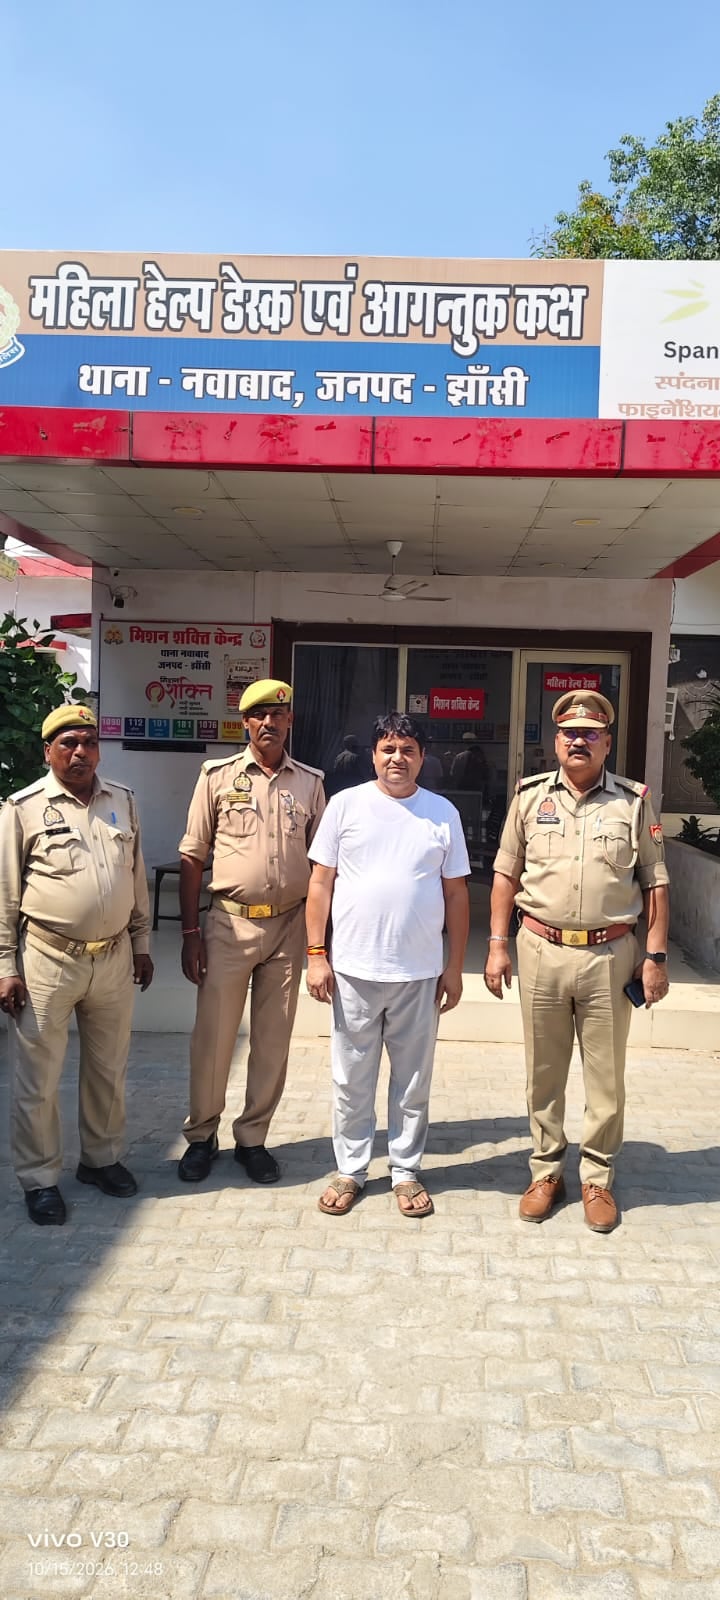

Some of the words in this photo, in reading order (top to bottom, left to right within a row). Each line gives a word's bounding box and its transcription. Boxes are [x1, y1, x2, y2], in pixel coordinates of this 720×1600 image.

[29, 261, 140, 331] महिला
[142, 261, 218, 332] हेल्प
[220, 262, 297, 334] डेस्क
[300, 263, 358, 336] एवं
[361, 279, 511, 358] आगन्तुक
[513, 284, 590, 340] कक्ष
[664, 341, 719, 363] Span
[79, 364, 152, 396] थाना
[180, 367, 305, 408] नवाबाद,
[314, 370, 416, 404] जनपद
[445, 364, 530, 407] झाँसी
[655, 371, 720, 390] स्पंदना
[618, 398, 720, 419] फाइनेंशिय
[129, 626, 169, 644] मिशन
[173, 627, 211, 645] शक्ति
[214, 628, 243, 646] केन्द्र
[158, 661, 182, 669] जनपद
[546, 676, 567, 688] महिला
[433, 695, 449, 711] मिशन
[128, 718, 144, 726] 112
